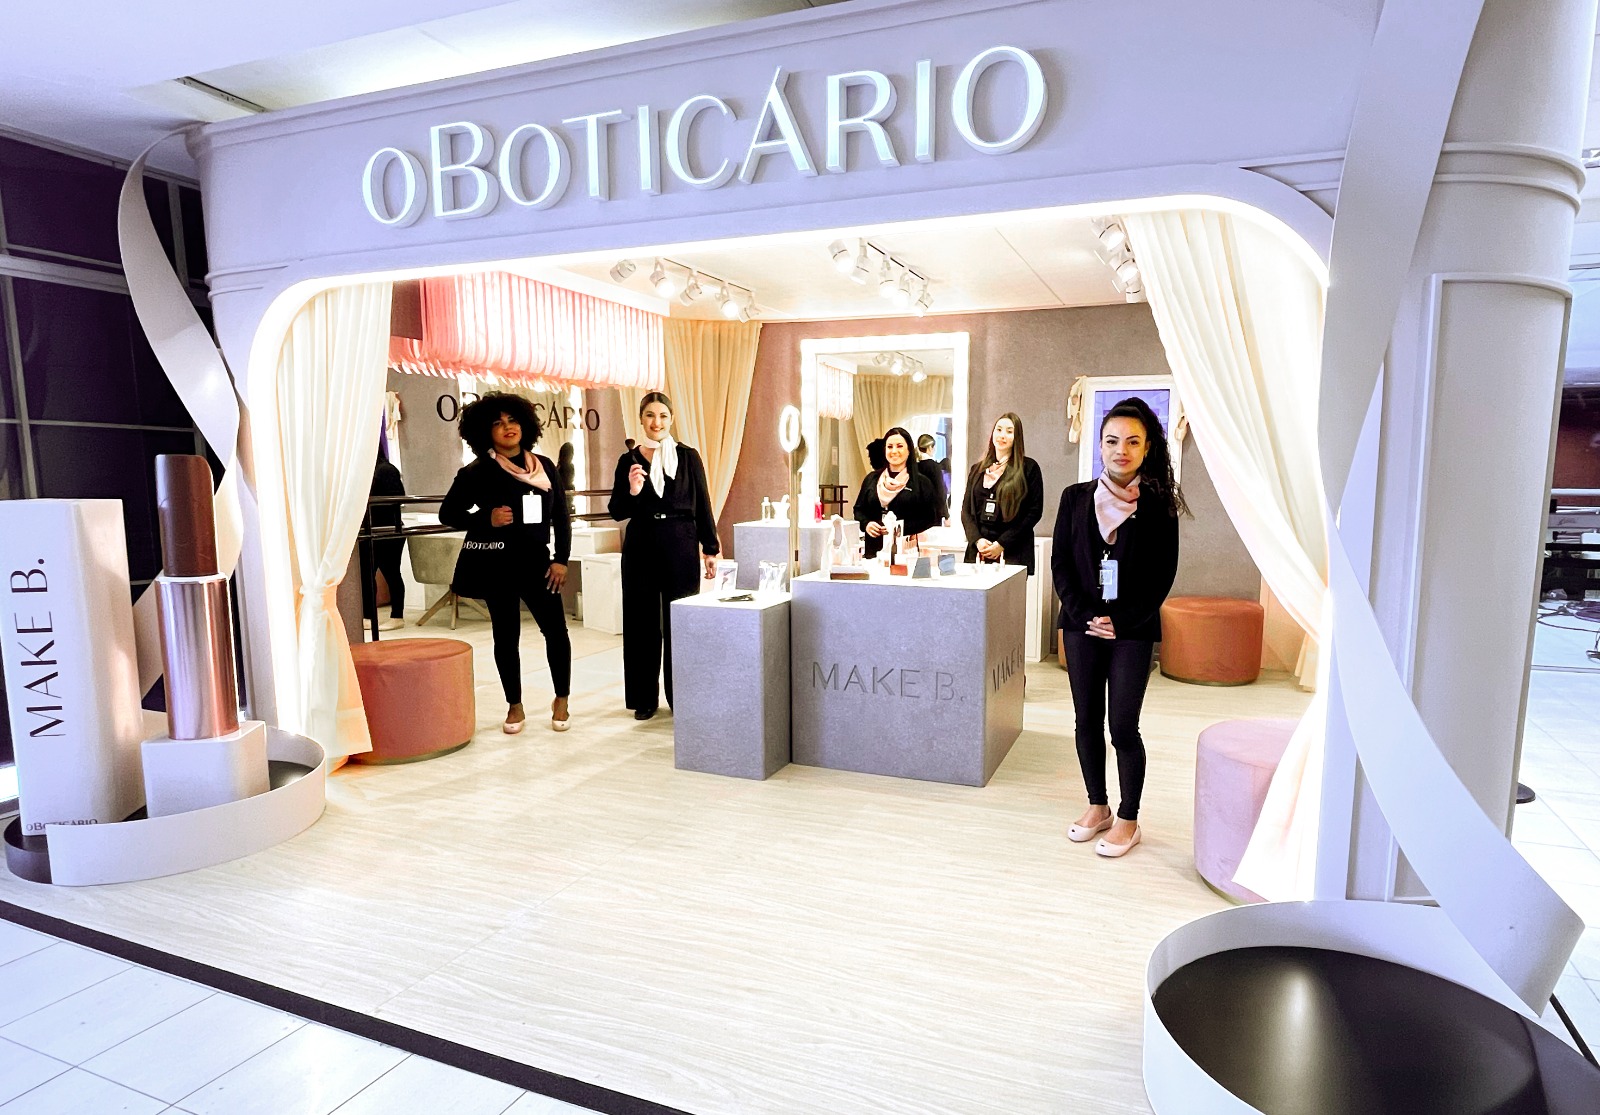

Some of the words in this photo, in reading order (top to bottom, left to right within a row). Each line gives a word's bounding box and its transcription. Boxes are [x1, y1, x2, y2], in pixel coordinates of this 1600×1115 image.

[10, 558, 48, 594] B.
[14, 611, 67, 738] MAKE
[812, 661, 921, 699] MAKE
[935, 671, 967, 702] B.
